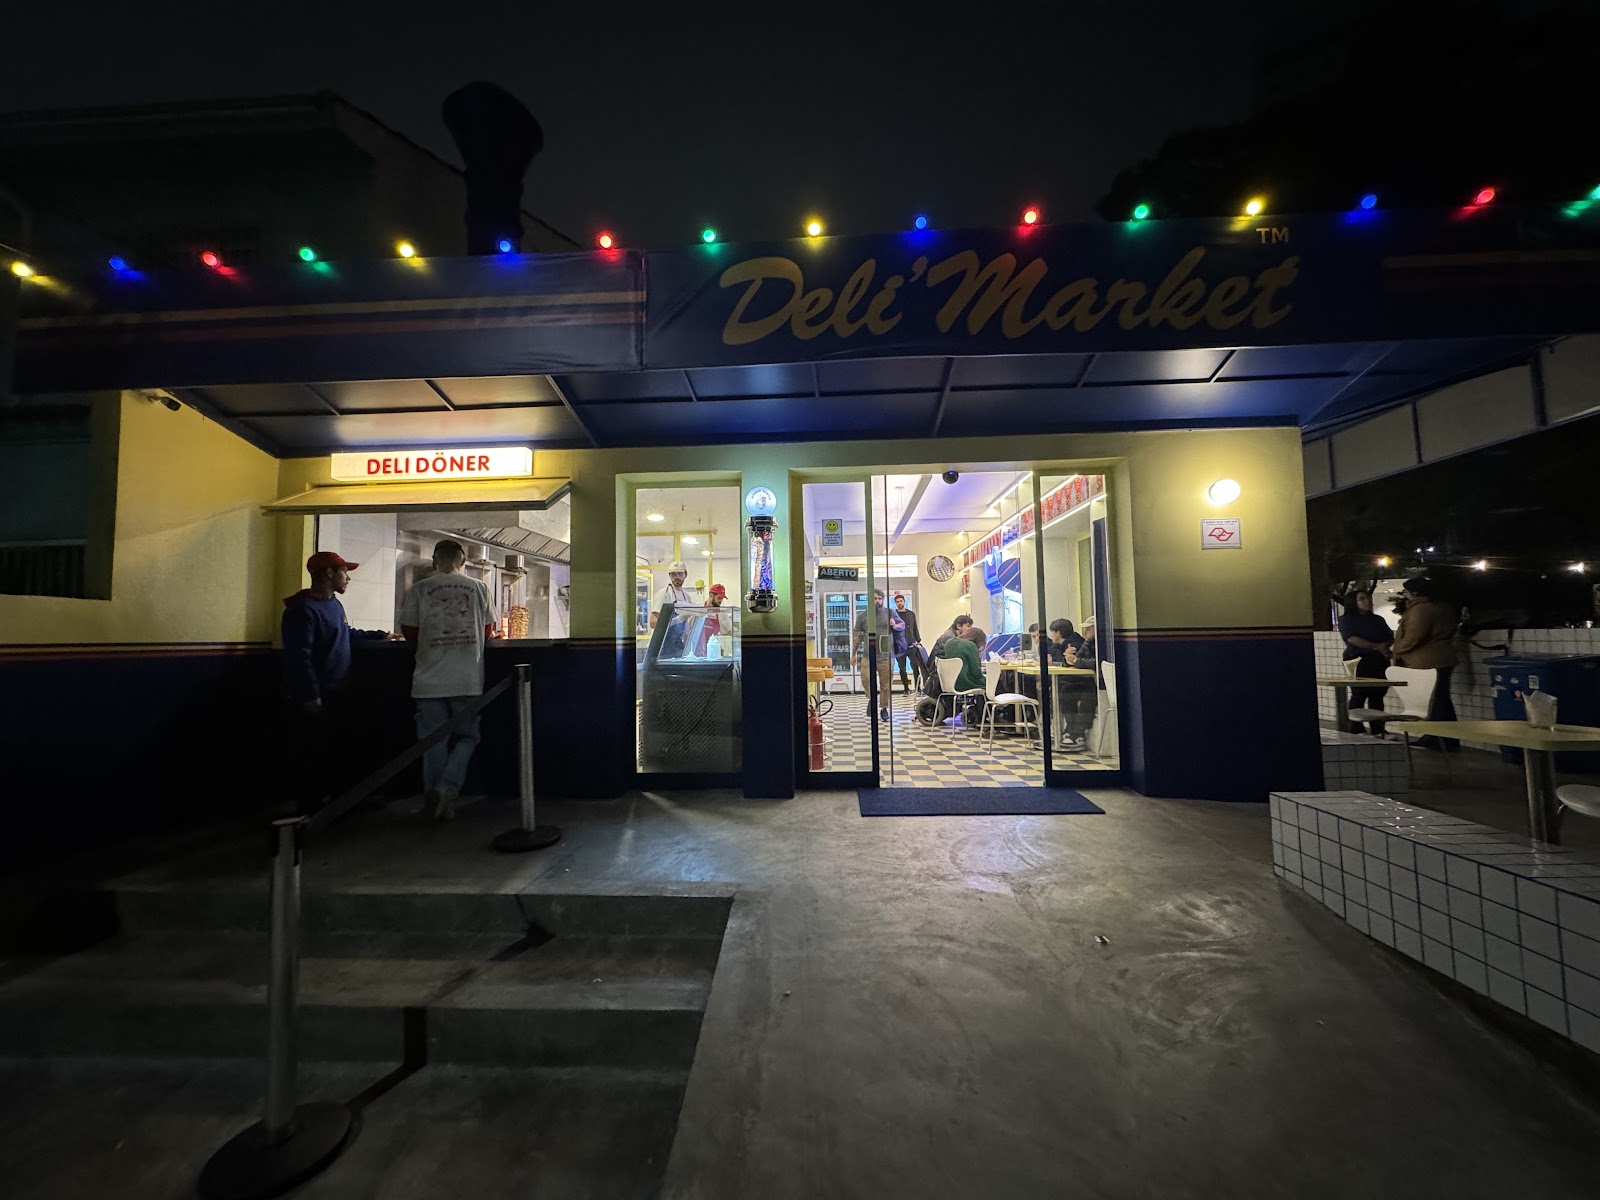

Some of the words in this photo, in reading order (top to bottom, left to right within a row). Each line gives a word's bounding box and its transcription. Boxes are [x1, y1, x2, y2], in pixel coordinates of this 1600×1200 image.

[1255, 227, 1289, 244] TM
[367, 458, 409, 475] DELI
[416, 452, 490, 473] DÖNER
[820, 567, 857, 578] ABERTO
